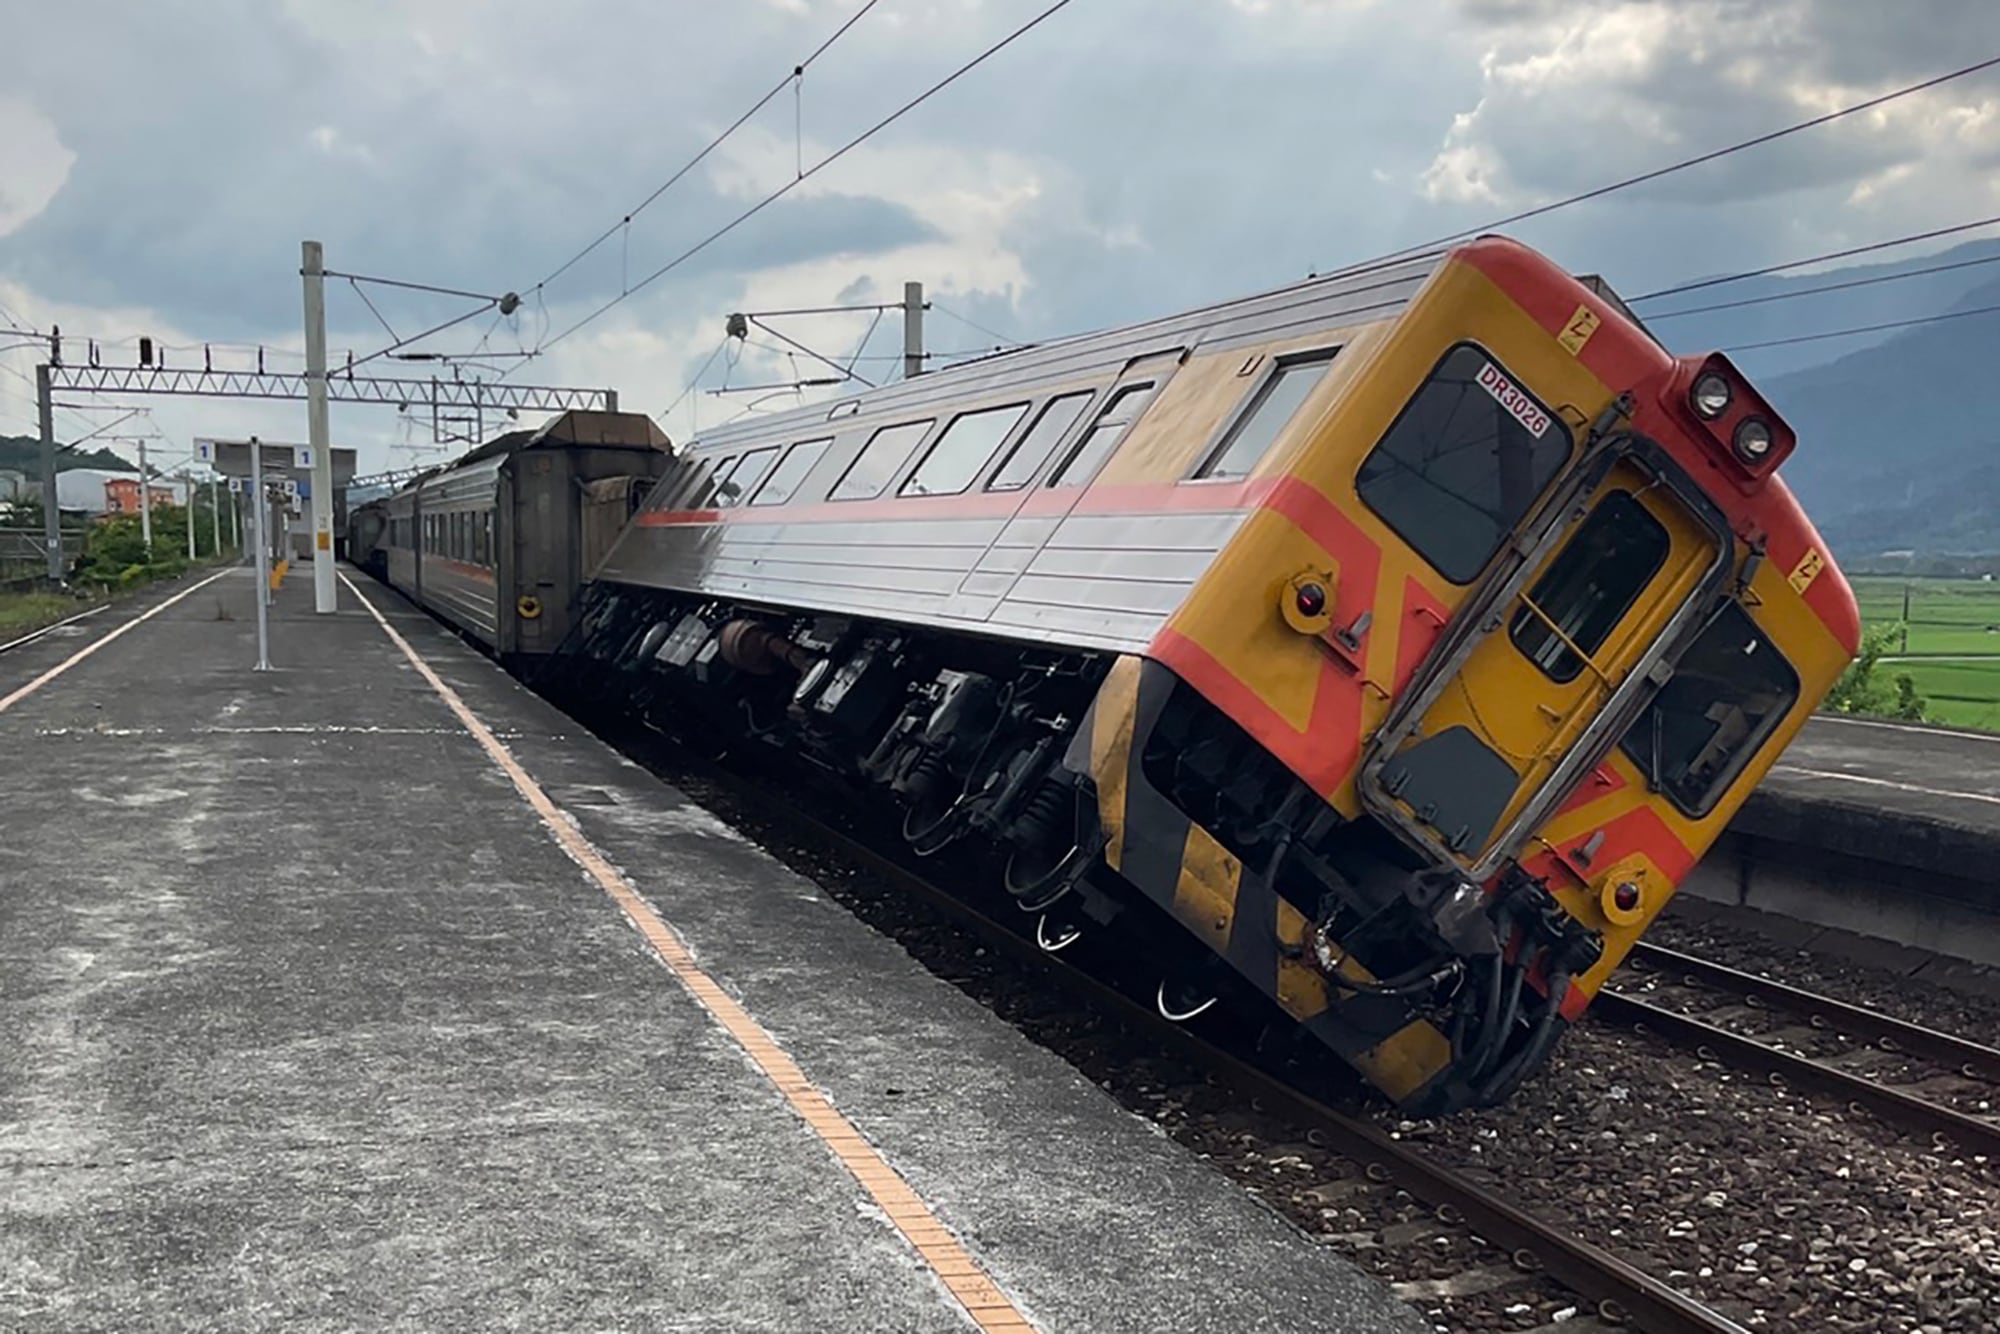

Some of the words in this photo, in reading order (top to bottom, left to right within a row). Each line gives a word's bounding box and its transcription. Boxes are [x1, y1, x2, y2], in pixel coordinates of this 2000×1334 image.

[1481, 366, 1547, 433] DR3026
[200, 445, 207, 459] 1
[301, 451, 309, 464] 1
